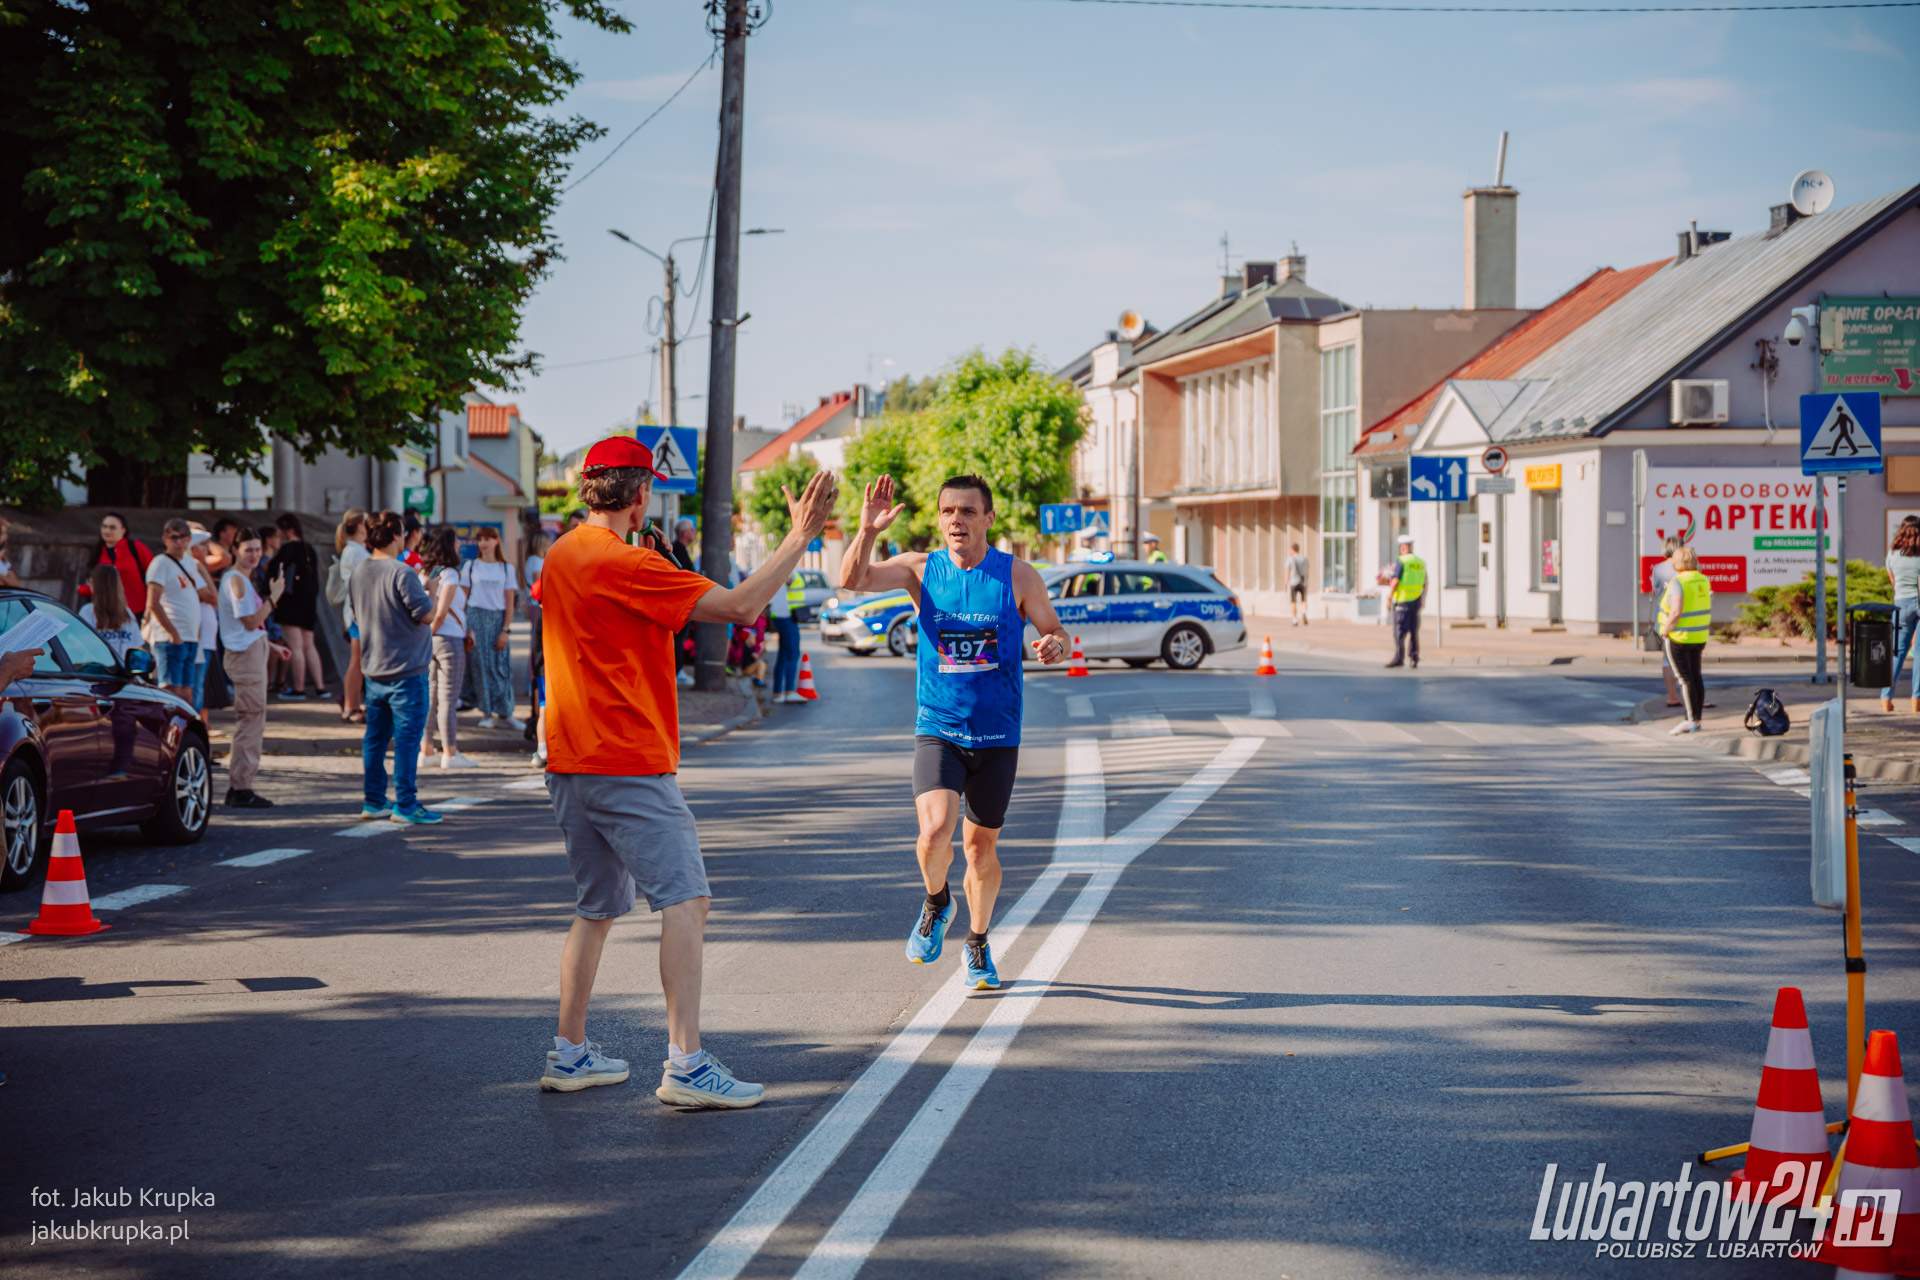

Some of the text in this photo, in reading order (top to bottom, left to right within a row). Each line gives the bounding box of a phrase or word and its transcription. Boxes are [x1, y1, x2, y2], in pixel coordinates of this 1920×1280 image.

[1704, 503, 1829, 530] APTEKA
[973, 613, 998, 622] TEAM
[948, 640, 985, 658] 197
